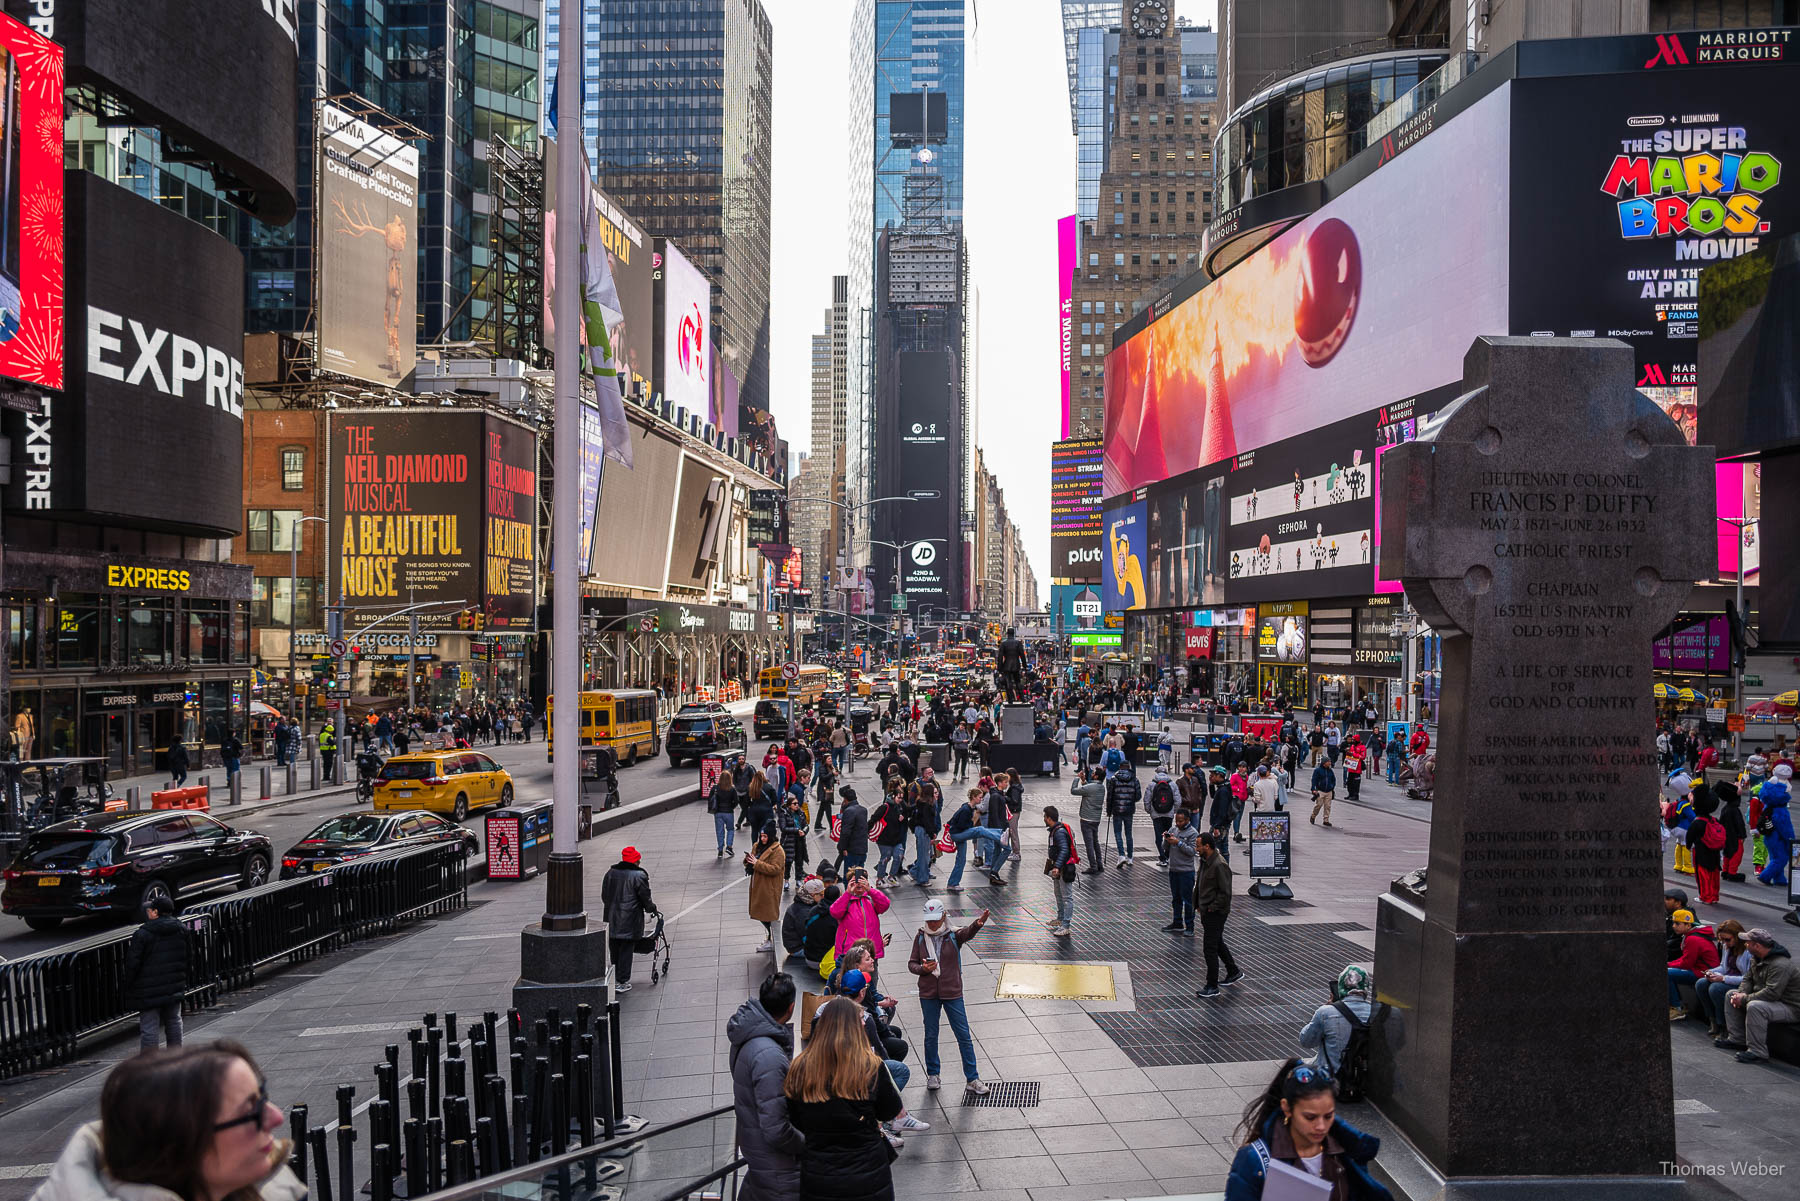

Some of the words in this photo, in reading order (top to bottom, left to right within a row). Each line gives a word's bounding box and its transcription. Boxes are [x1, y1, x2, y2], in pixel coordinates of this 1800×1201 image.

[1700, 31, 1791, 45] MARRIOTT
[1700, 47, 1780, 61] MARQUIS
[1398, 103, 1438, 137] MARRIOTT
[1630, 117, 1662, 125] Nintendo
[1681, 113, 1719, 124] ILLUMINATION
[327, 112, 364, 142] MoMA
[1398, 120, 1432, 150] MARQUIS
[1621, 139, 1652, 153] THE
[1653, 127, 1747, 153] SUPER
[327, 145, 375, 177] Guillermo
[375, 168, 390, 185] del
[390, 174, 414, 196] Toro:
[1600, 152, 1782, 198] MARIO
[327, 159, 368, 190] Crafting
[368, 176, 412, 208] Pinocchio
[1210, 206, 1243, 231] MARRIOTT
[1617, 193, 1771, 238] BROS.
[1210, 221, 1238, 243] MARQUIS
[614, 228, 631, 266] PLAY
[1675, 237, 1760, 261] MOVIE
[1627, 269, 1660, 281] ONLY
[1664, 268, 1677, 280] IN
[1655, 303, 1670, 311] GET
[1668, 312, 1698, 320] FANDA
[1669, 327, 1684, 335] PG
[1390, 399, 1416, 413] MARRIOTT
[1390, 409, 1413, 421] MARQUIS
[345, 426, 374, 454] THE
[489, 431, 502, 461] THE
[678, 406, 770, 479] BROADWAY
[345, 455, 384, 483] NEIL
[386, 454, 468, 483] DIAMOND
[488, 459, 504, 487] NEIL
[506, 464, 535, 496] DIAMOND
[1481, 471, 1568, 488] LIEUTENANT
[1573, 473, 1644, 488] COLONEL
[345, 483, 413, 512] MUSICAL
[488, 487, 516, 519] MUSICAL
[1470, 491, 1557, 512] FRANCIS
[1585, 494, 1658, 514] DUFFY
[1278, 520, 1308, 535] SEPHORA
[1480, 517, 1509, 531] MAY
[1600, 519, 1612, 532] 26
[1617, 519, 1646, 533] 1932
[343, 515, 355, 555] A
[360, 514, 462, 556] BEAUTIFUL
[488, 516, 494, 555] A
[494, 519, 533, 561] BEAUTIFUL
[915, 547, 932, 560] JD
[1493, 543, 1569, 558] CATHOLIC
[1578, 544, 1633, 559] PRIEST
[107, 564, 191, 591] EXPRESS
[343, 556, 398, 597] NOISE
[487, 555, 510, 596] NOISE
[1527, 582, 1599, 597] CHAPLAIN
[1076, 604, 1099, 613] BT21
[1368, 597, 1391, 606] SEPHORA
[1493, 604, 1533, 618] 165TH
[1568, 605, 1634, 618] INFANTRY
[729, 611, 749, 630] FOREVER
[1512, 625, 1541, 638] OLD
[1546, 625, 1580, 638] 69TH
[354, 634, 437, 647] LUGGAGE
[1495, 665, 1506, 679] A
[1512, 665, 1542, 679] LIFE
[1549, 665, 1569, 679] OF
[1573, 665, 1634, 679] SERVICE
[1550, 682, 1576, 693] FOR
[103, 695, 137, 706] EXPRESS
[154, 692, 184, 703] EXPRESS
[583, 697, 593, 705] BUS
[1488, 697, 1525, 709] GOD
[1527, 697, 1562, 709] AND
[1566, 697, 1637, 710] COUNTRY
[1485, 735, 1537, 748] SPANISH
[1540, 735, 1608, 748] AMERICAN
[1611, 736, 1641, 748] WAR
[1469, 755, 1497, 766] NEW
[1501, 755, 1537, 767] YORK
[1542, 755, 1606, 767] NATIONAL
[1610, 755, 1657, 767] GUARD
[1503, 773, 1564, 785] MEXICAN
[1568, 773, 1622, 785] BORDER
[1518, 791, 1568, 803] WORLD
[1575, 791, 1606, 803] WAR
[1464, 830, 1560, 844] DISTINGUISHED
[1564, 829, 1613, 842] SERVICE
[1618, 829, 1659, 841] CROSS
[1464, 848, 1560, 862] DISTINGUISHED
[1564, 848, 1613, 861] SERVICE
[1618, 848, 1661, 861] MEDAL
[1463, 868, 1558, 881] CONSPICUOUS
[1564, 867, 1613, 880] SERVICE
[1618, 867, 1659, 879] CROSS
[1497, 886, 1544, 898] LEGION
[1497, 904, 1542, 917] CROIX
[1549, 904, 1566, 916] DE
[1574, 903, 1627, 916] GUERRE
